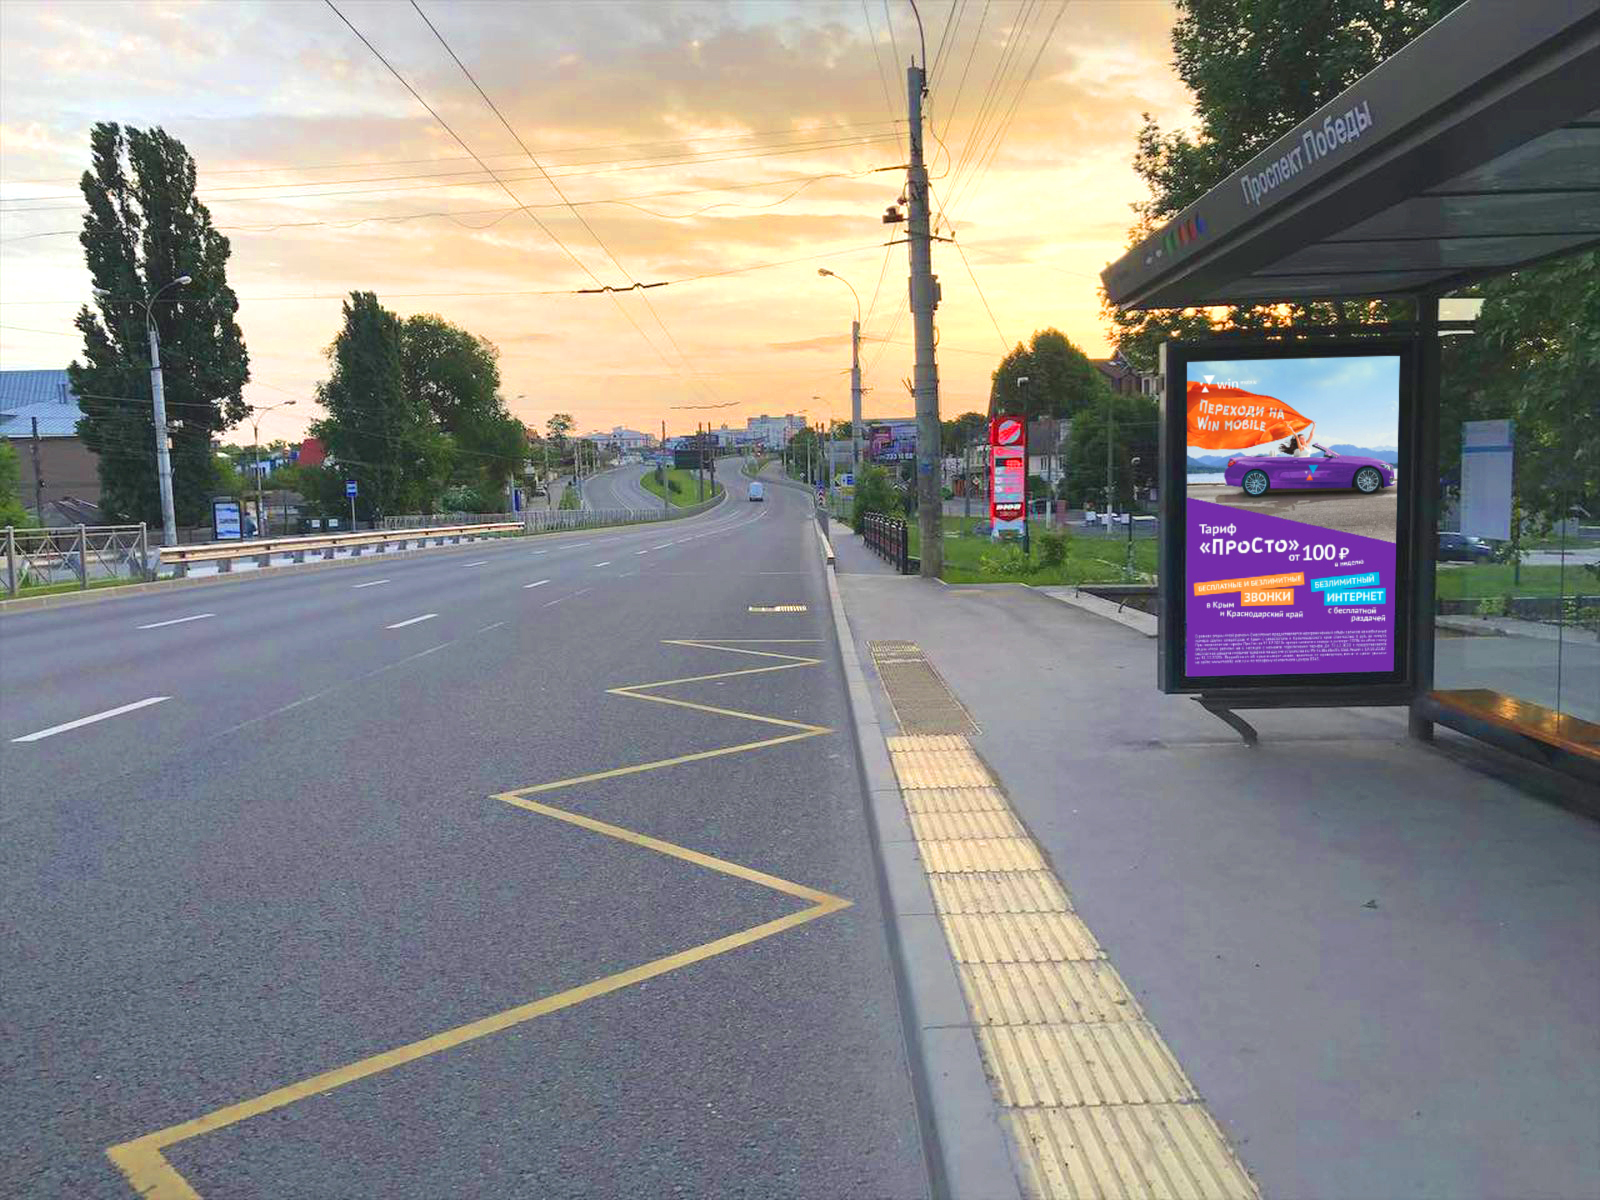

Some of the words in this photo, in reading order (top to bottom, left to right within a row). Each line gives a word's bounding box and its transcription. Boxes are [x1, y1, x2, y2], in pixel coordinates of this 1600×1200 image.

[1240, 143, 1305, 206] Проспект
[1301, 100, 1373, 165] Победы
[1217, 378, 1239, 389] win
[1199, 523, 1237, 536] Тариф
[1288, 553, 1301, 562] от
[1302, 544, 1336, 561] 100
[1198, 581, 1243, 592] БЕСПЛАТНЫЕ
[1243, 580, 1250, 588] И
[1250, 574, 1302, 587] БЕЗЛИМИТНЫЕ
[1314, 573, 1375, 589] БЕЗЛИМИТНЫЙ
[1243, 591, 1291, 603] ЗВОНКИ
[1326, 590, 1384, 603] ИНТЕРНЕТ
[1212, 601, 1235, 610] Крым
[1333, 606, 1377, 615] бесплатной
[1226, 609, 1284, 619] Краснодарский
[1285, 610, 1304, 620] край
[1350, 614, 1386, 623] раздачей
